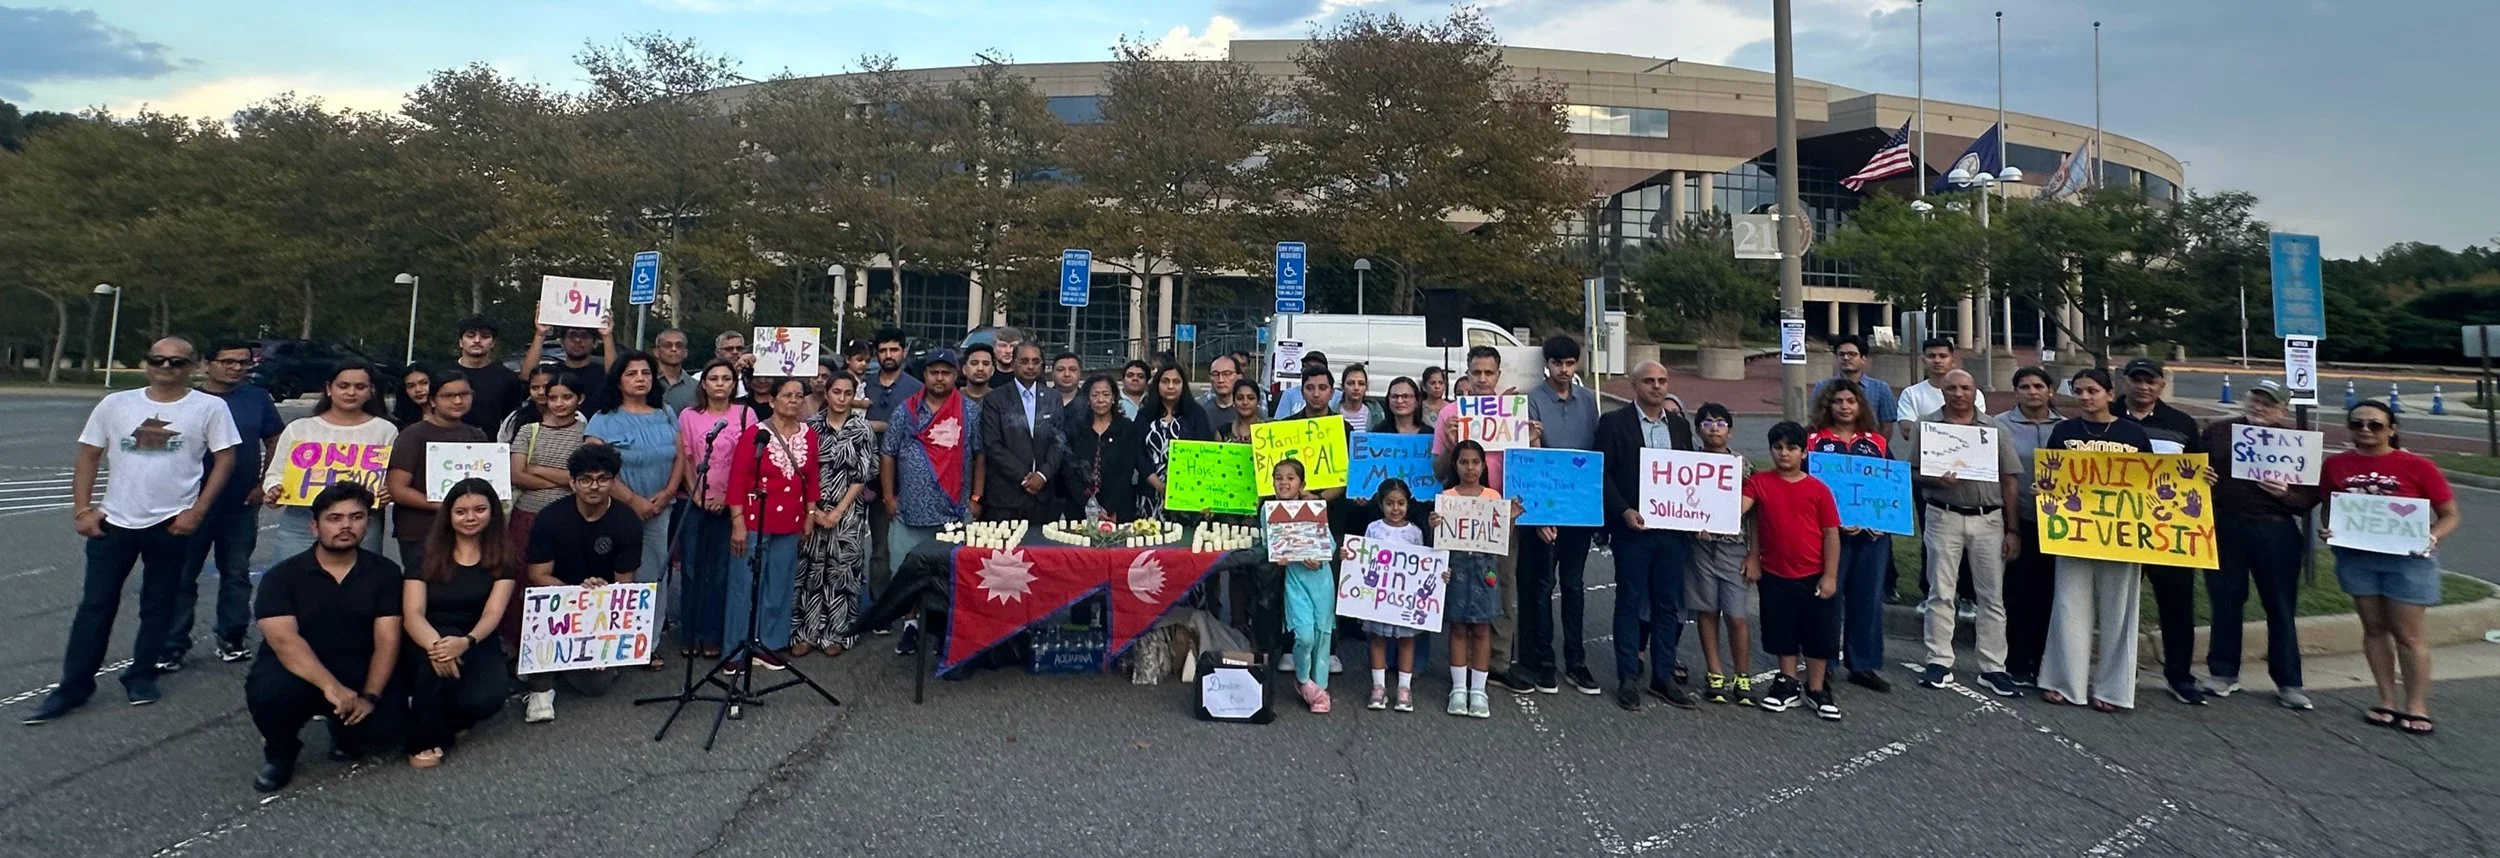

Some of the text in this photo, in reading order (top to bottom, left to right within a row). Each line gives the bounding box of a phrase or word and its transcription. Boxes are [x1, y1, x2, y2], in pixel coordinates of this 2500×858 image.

[1735, 221, 1778, 251] 21
[1460, 395, 1526, 417] HELP
[1255, 420, 1333, 450] Stand for
[1353, 436, 1408, 460] Every
[290, 442, 387, 470] ONE
[443, 458, 493, 472] Candle
[1686, 486, 1700, 508] &
[2090, 489, 2144, 520] IN
[2336, 498, 2387, 517] WE
[1440, 516, 1499, 544] NEPAL
[2047, 515, 2215, 560] DIVERSITY
[2345, 514, 2429, 539] NEPAL
[1346, 537, 1443, 576] Stronger
[1382, 565, 1406, 591] in
[1339, 573, 1441, 614] Compassion
[547, 610, 634, 636] WE ARE
